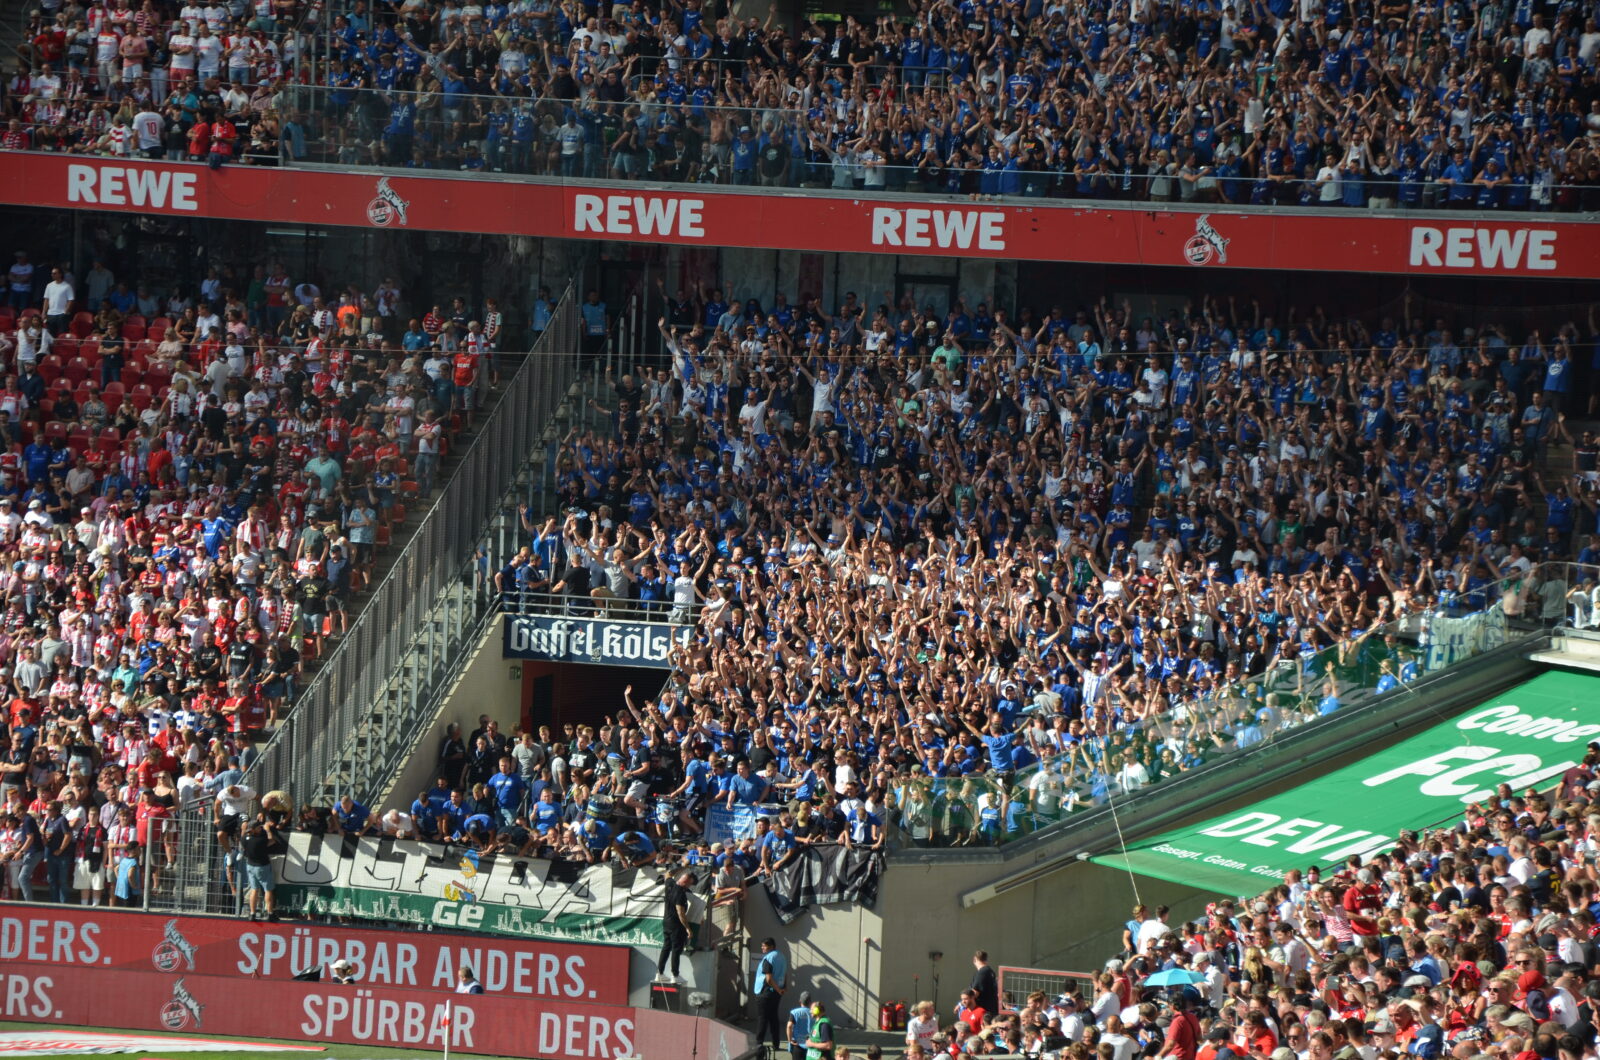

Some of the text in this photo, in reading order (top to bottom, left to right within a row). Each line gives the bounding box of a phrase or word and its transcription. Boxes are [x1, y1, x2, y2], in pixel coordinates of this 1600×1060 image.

[67, 164, 198, 211] REWE
[574, 194, 705, 237] REWE
[871, 207, 1006, 251] REWE
[1409, 226, 1558, 270] REWE
[1456, 704, 1600, 743] Come
[237, 927, 597, 999] SPÜRBAR ANDERS.
[0, 973, 63, 1019] RS.
[301, 989, 475, 1048] SPÜRBAR
